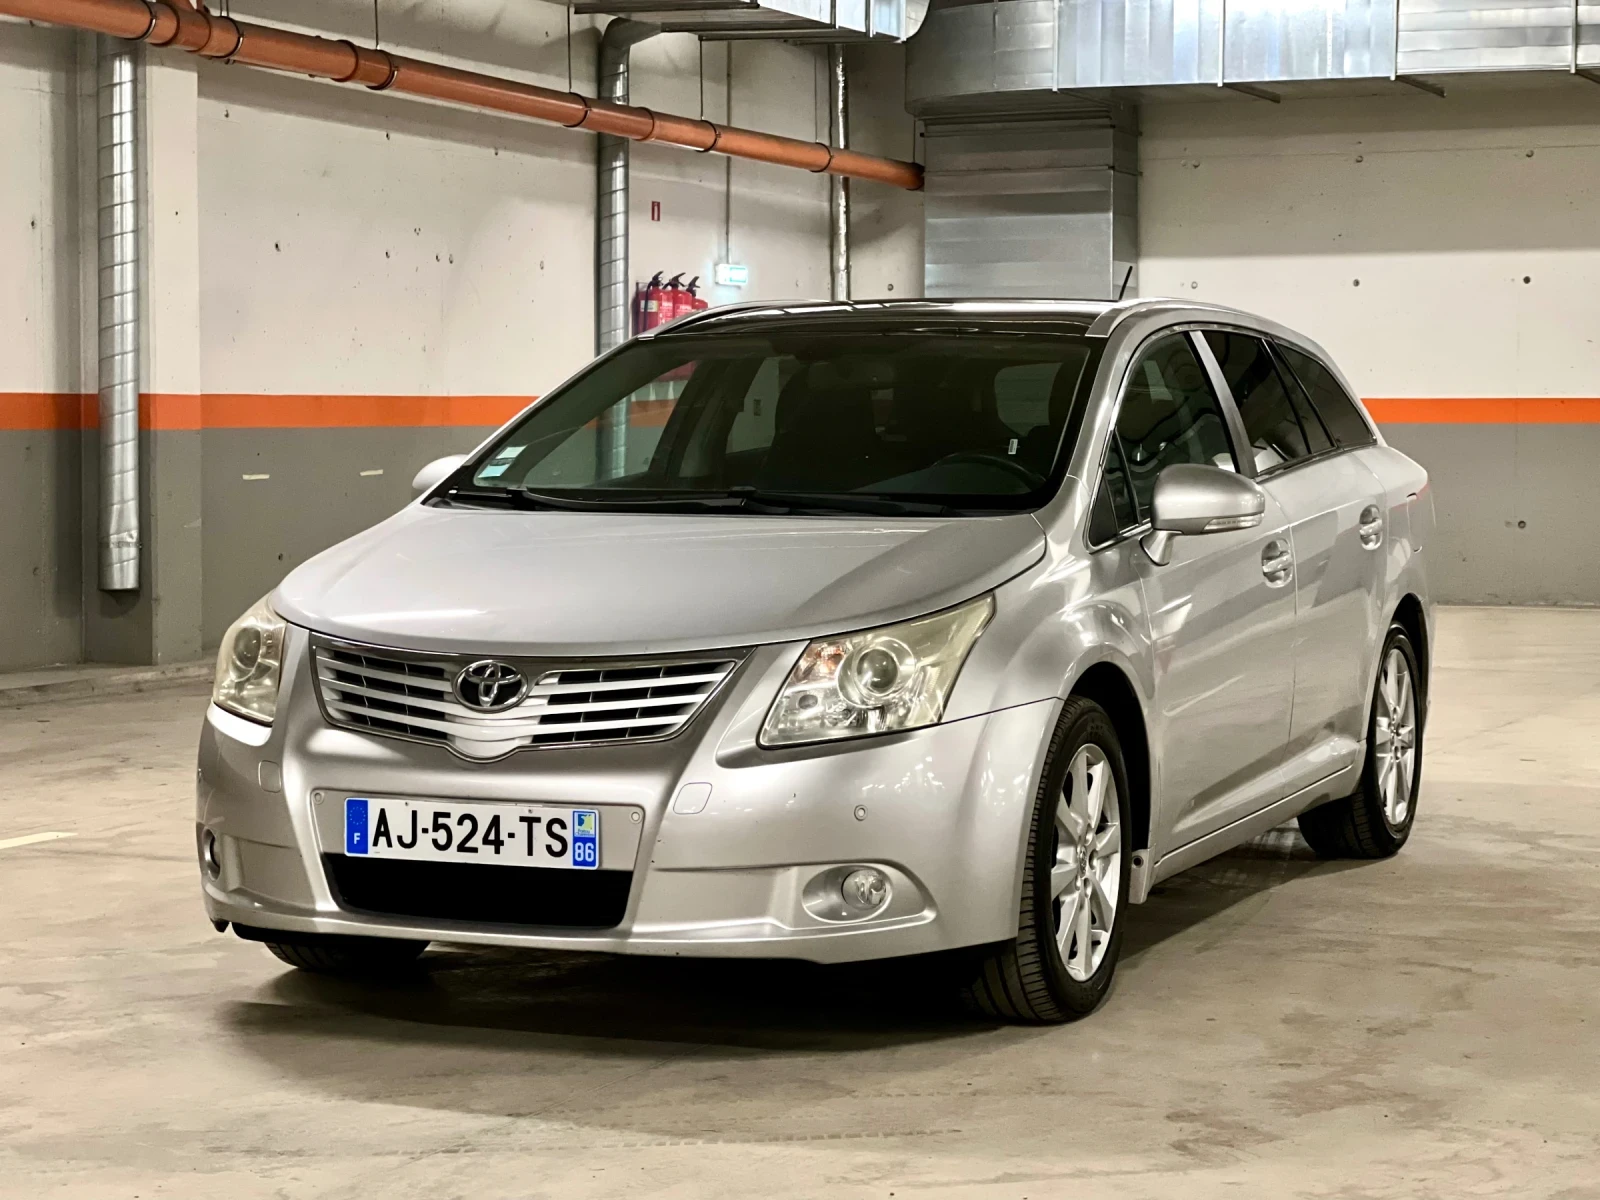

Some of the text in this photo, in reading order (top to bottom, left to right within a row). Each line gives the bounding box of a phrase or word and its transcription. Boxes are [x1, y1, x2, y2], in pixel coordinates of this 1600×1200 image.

[353, 832, 361, 845] F
[372, 807, 568, 857] AJ-524-TS
[574, 841, 595, 862] 86
